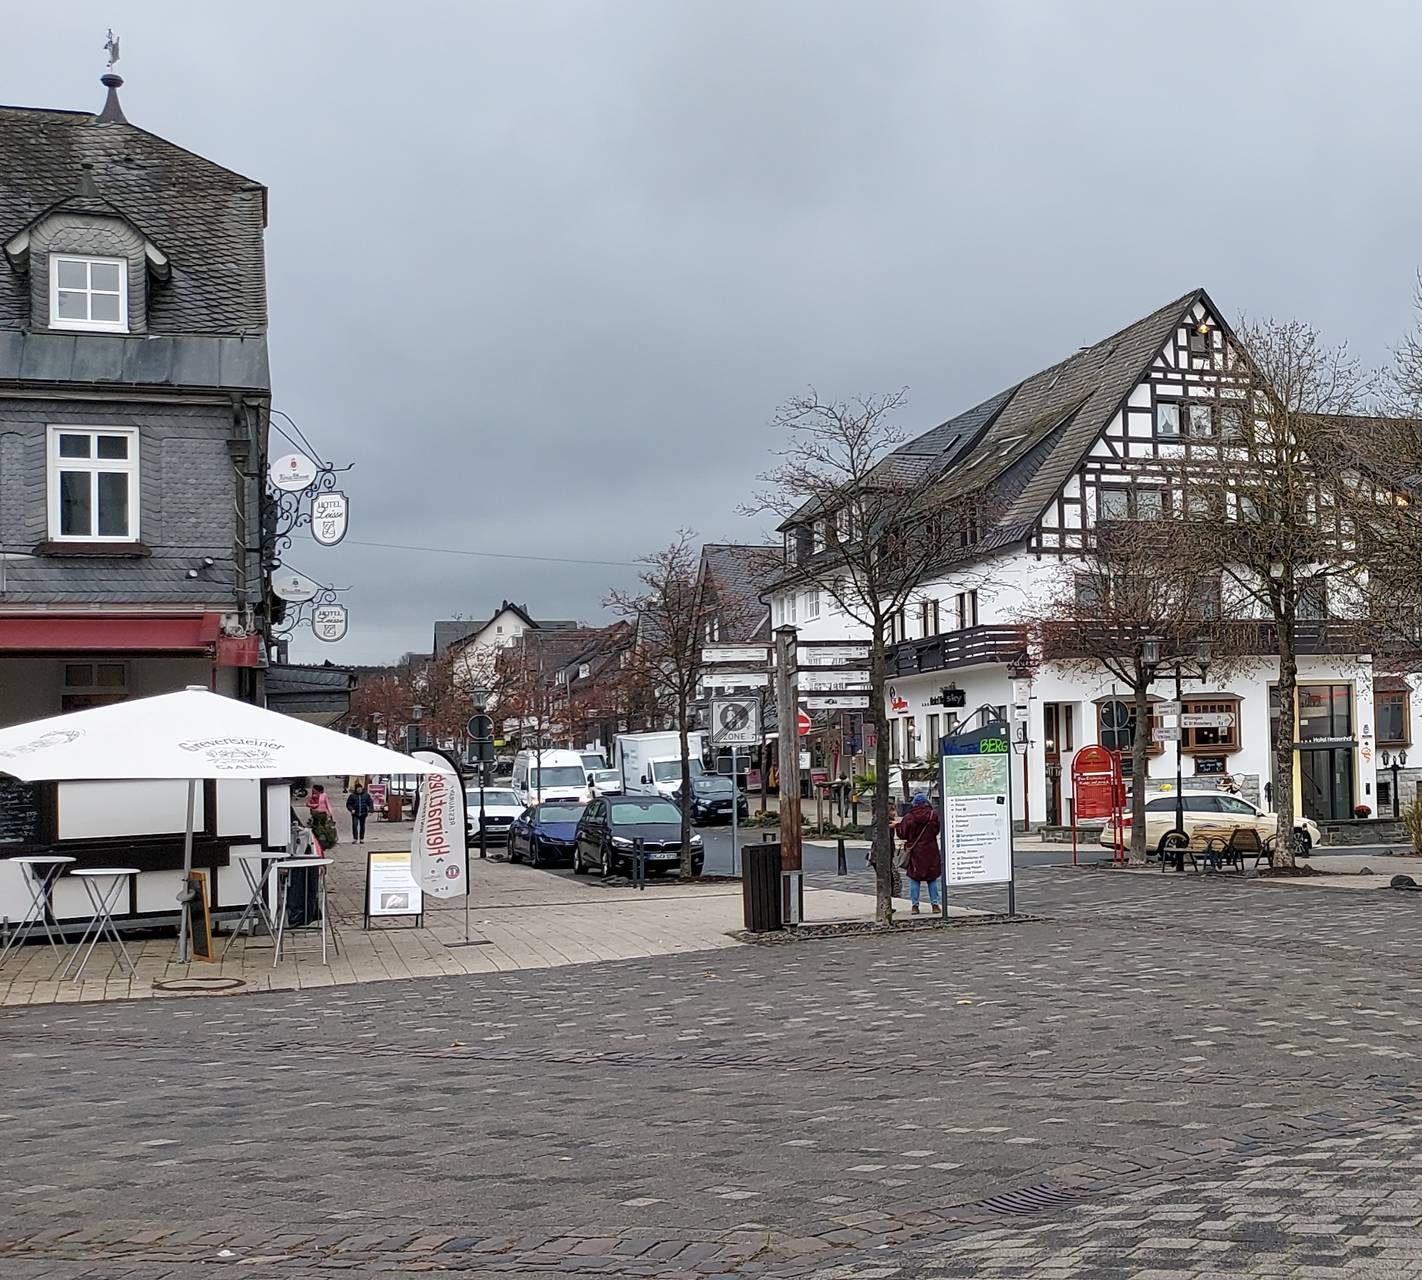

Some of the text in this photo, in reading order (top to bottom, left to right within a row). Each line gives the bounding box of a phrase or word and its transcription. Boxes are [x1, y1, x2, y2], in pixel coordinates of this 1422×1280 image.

[946, 693, 963, 704] sky
[723, 733, 746, 741] ZONE
[178, 738, 286, 752] Grevensteiner
